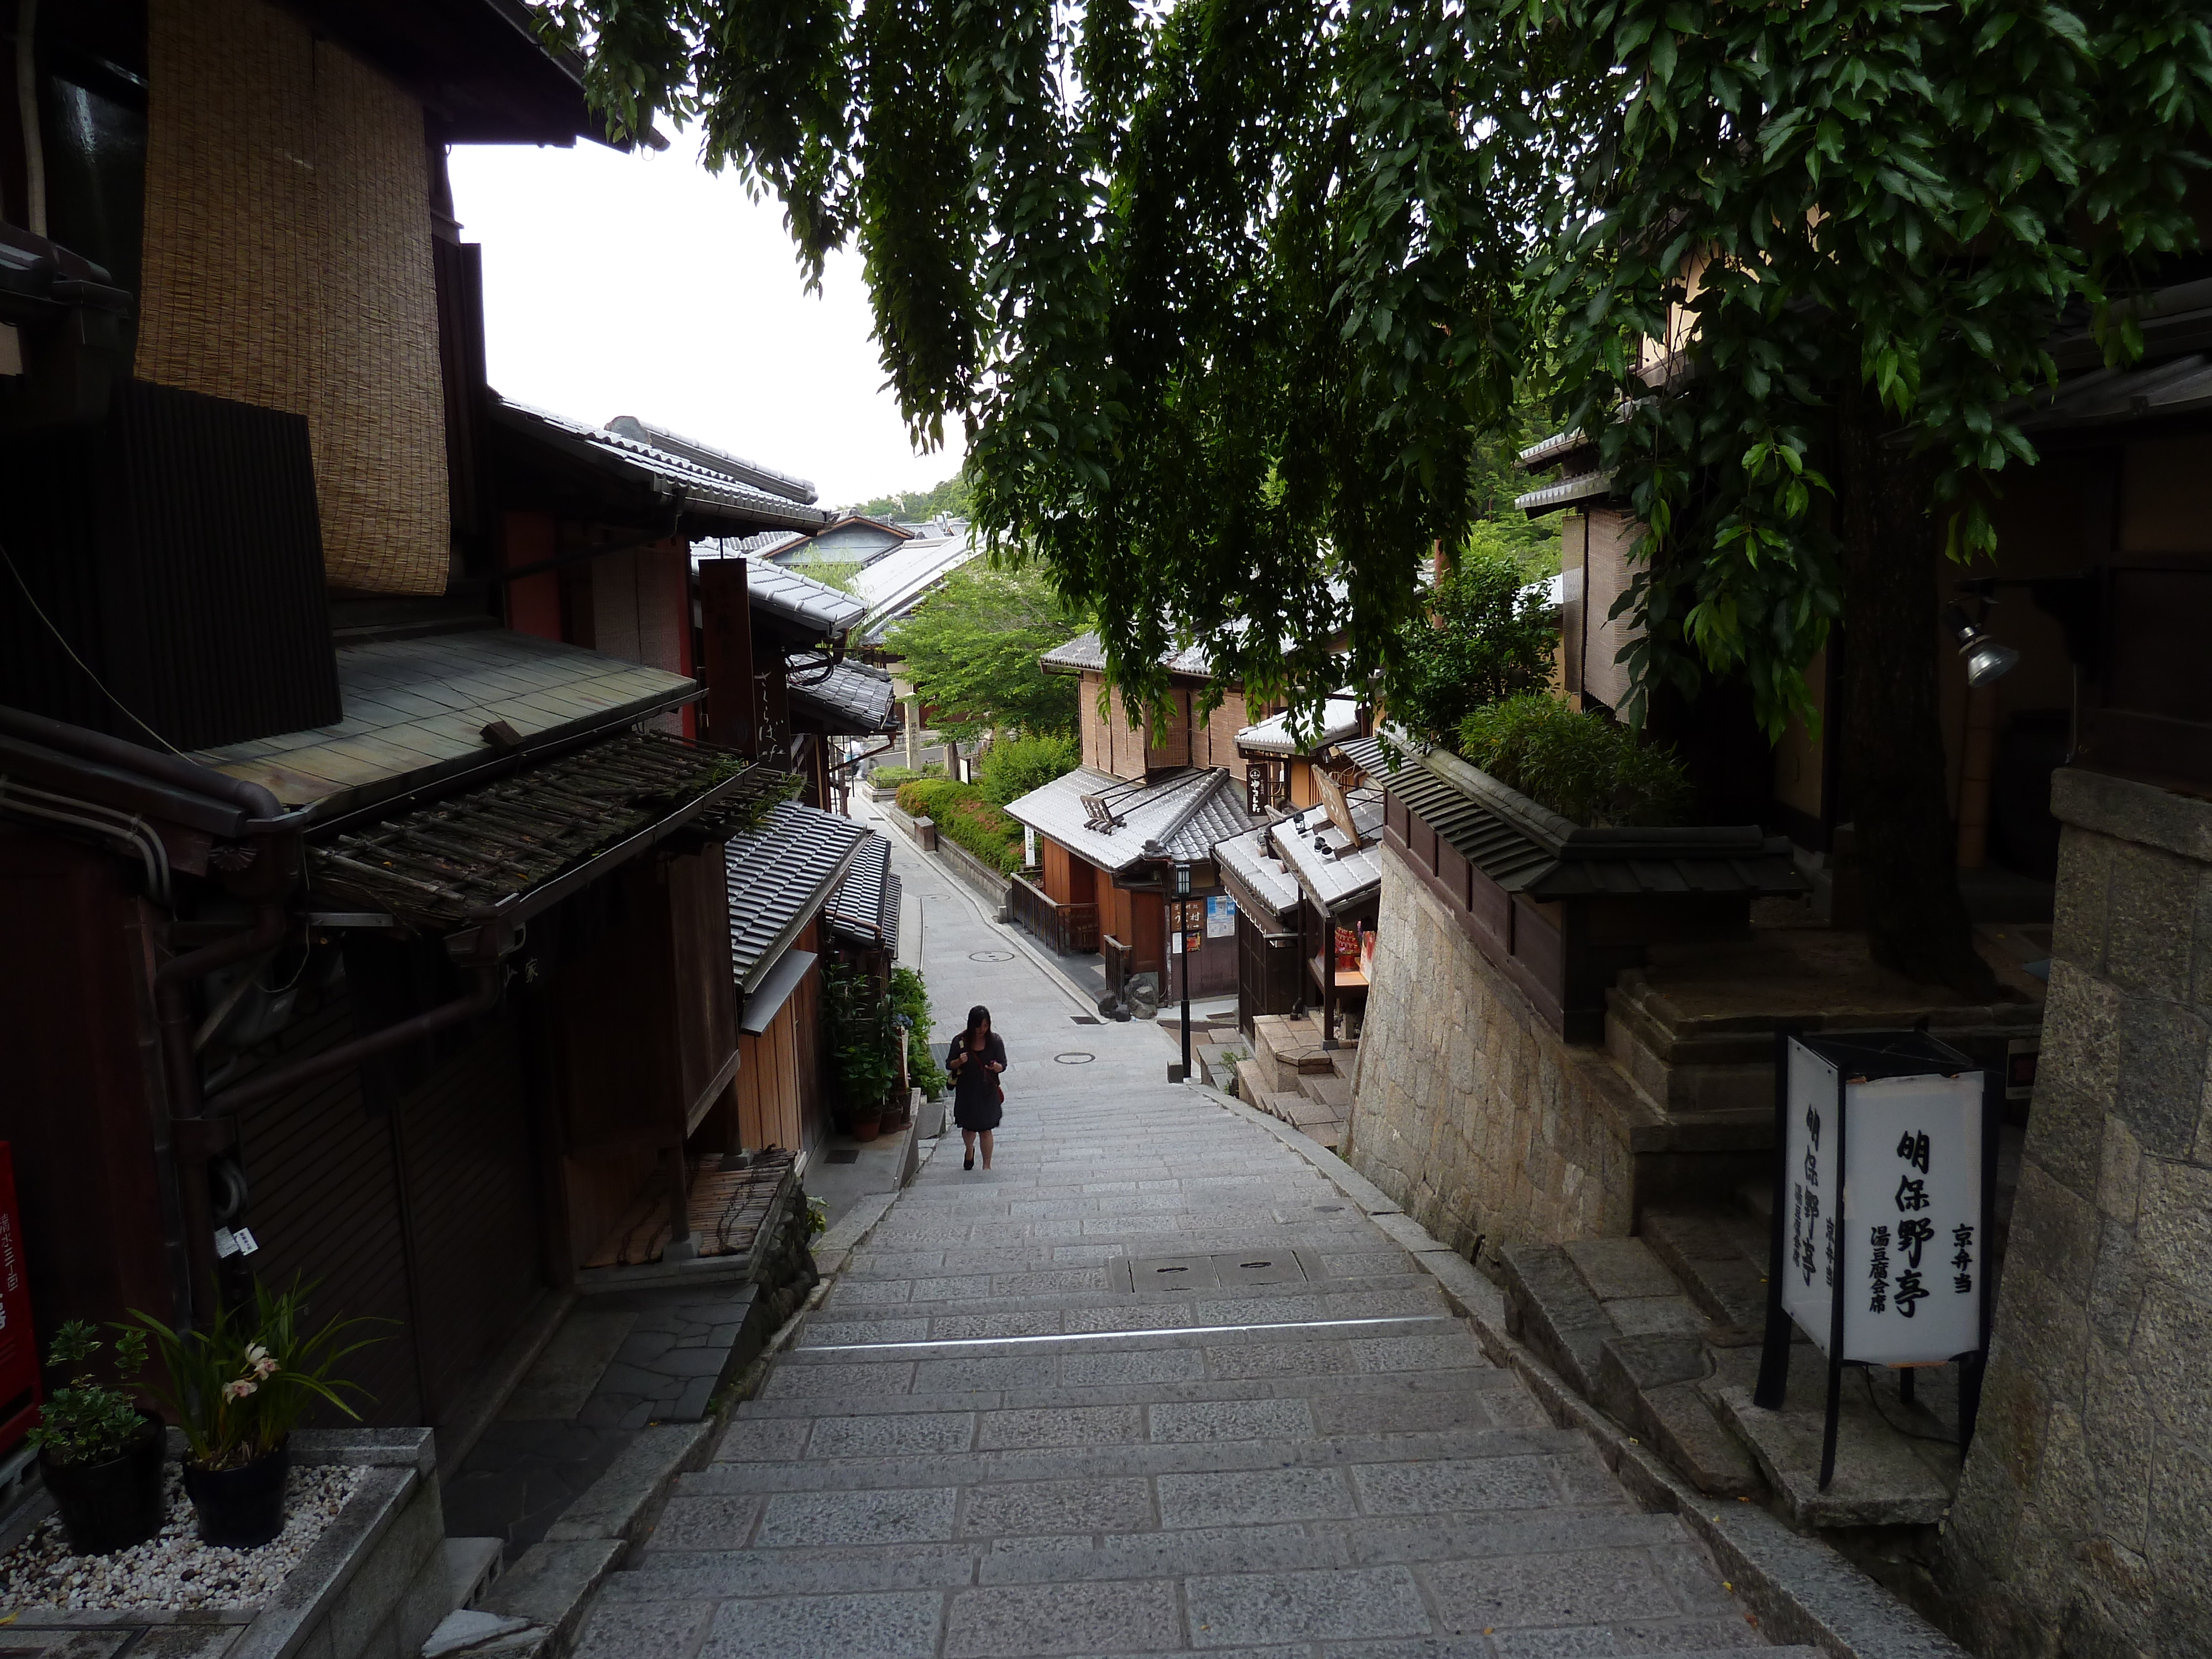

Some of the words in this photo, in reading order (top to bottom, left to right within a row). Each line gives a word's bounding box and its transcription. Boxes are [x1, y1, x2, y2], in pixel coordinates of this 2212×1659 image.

[757, 744, 786, 763] afe
[1175, 911, 1201, 924] う村
[1803, 1104, 1820, 1286] 明保野亭
[1894, 1130, 1934, 1318] 明保野亭
[1869, 1225, 1891, 1314] 湯豆腐会席
[1950, 1223, 1975, 1295] 京弁当
